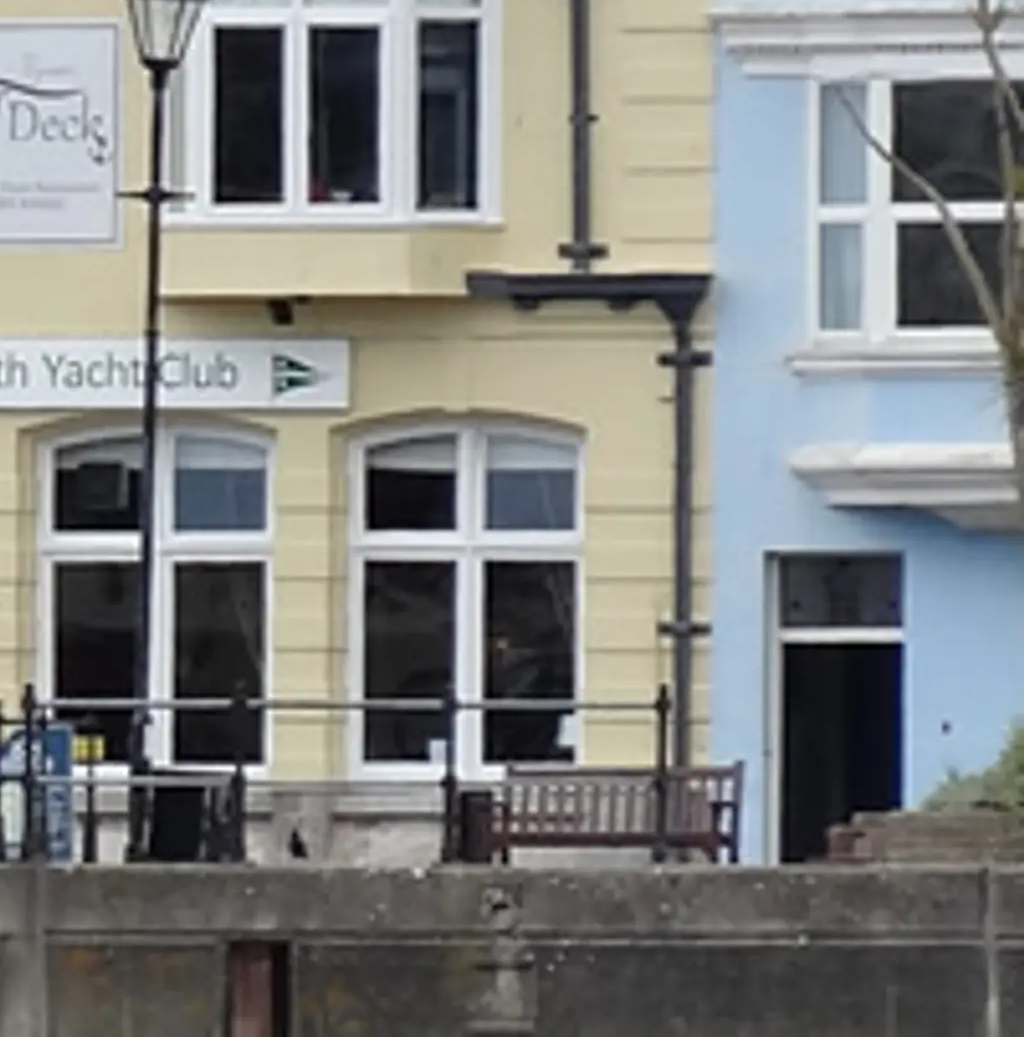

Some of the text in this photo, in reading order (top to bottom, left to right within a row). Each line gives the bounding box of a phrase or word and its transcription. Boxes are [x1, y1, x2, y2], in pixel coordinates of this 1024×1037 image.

[8, 91, 106, 143] Deck
[41, 351, 145, 389] Yacht
[156, 351, 240, 391] Club
